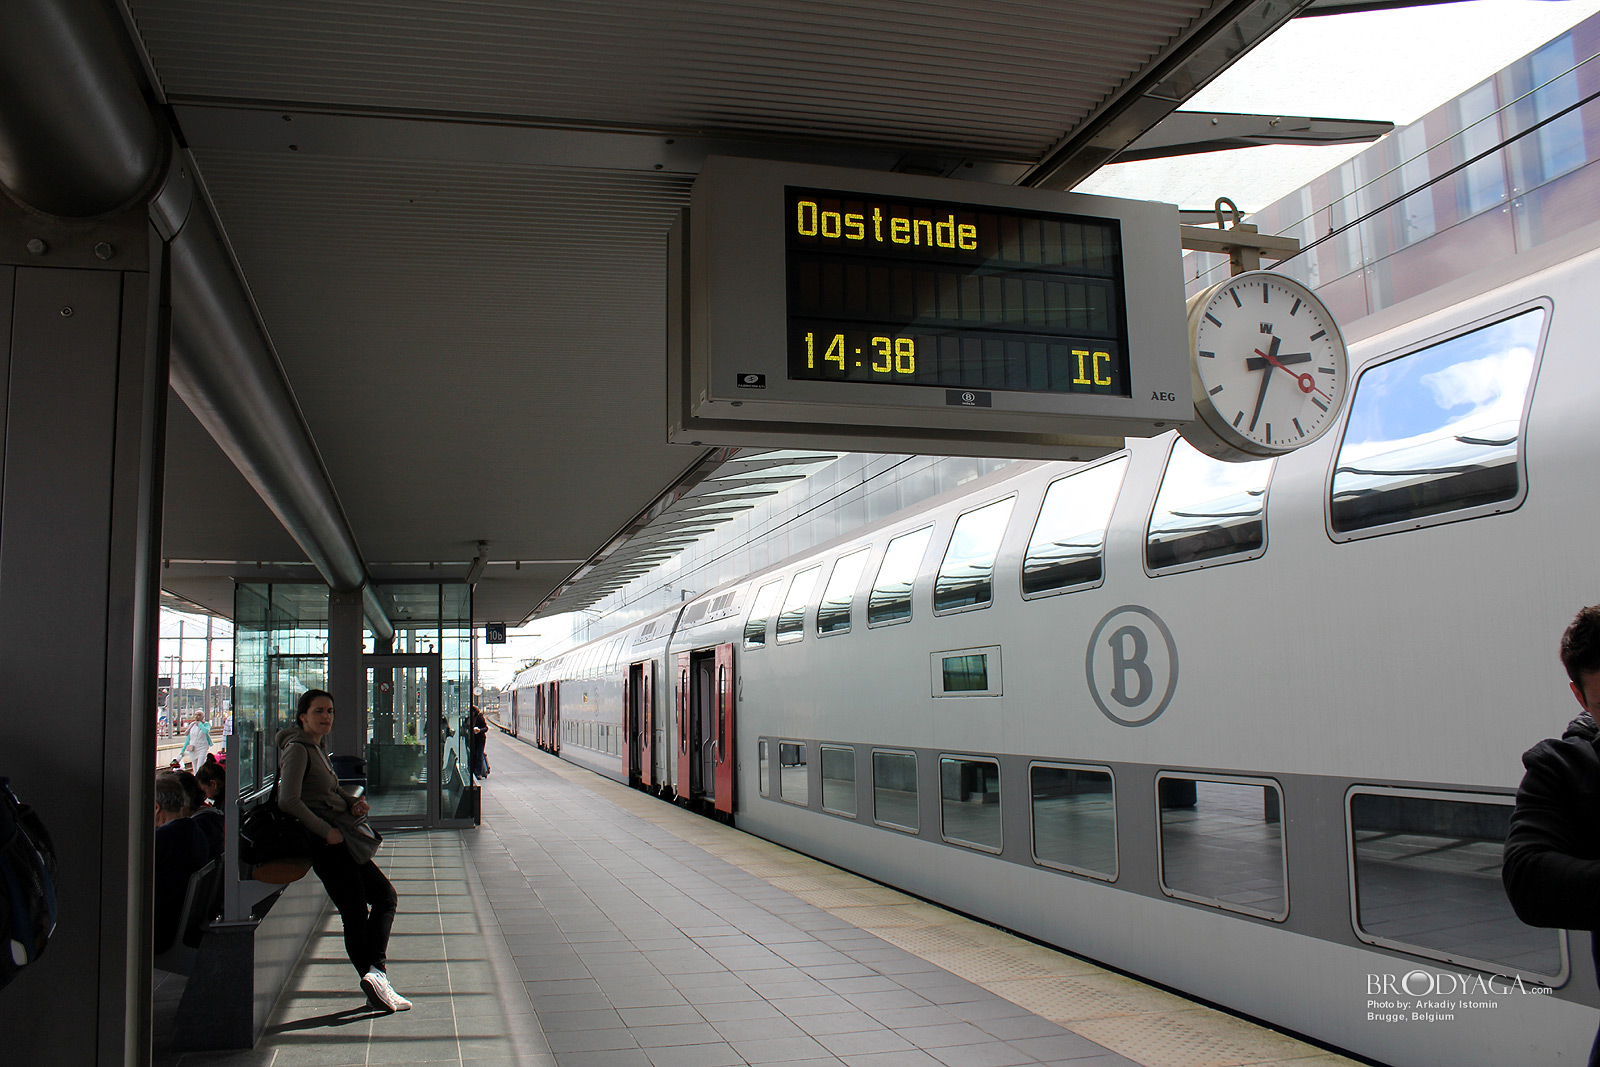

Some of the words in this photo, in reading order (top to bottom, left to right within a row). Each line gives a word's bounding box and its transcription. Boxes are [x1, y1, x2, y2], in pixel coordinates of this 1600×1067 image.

[797, 201, 977, 250] Oostende
[805, 332, 915, 374] 14:38
[1071, 350, 1112, 386] IC
[1151, 391, 1176, 402] AEG
[489, 630, 503, 641] 10b
[738, 676, 744, 702] 2
